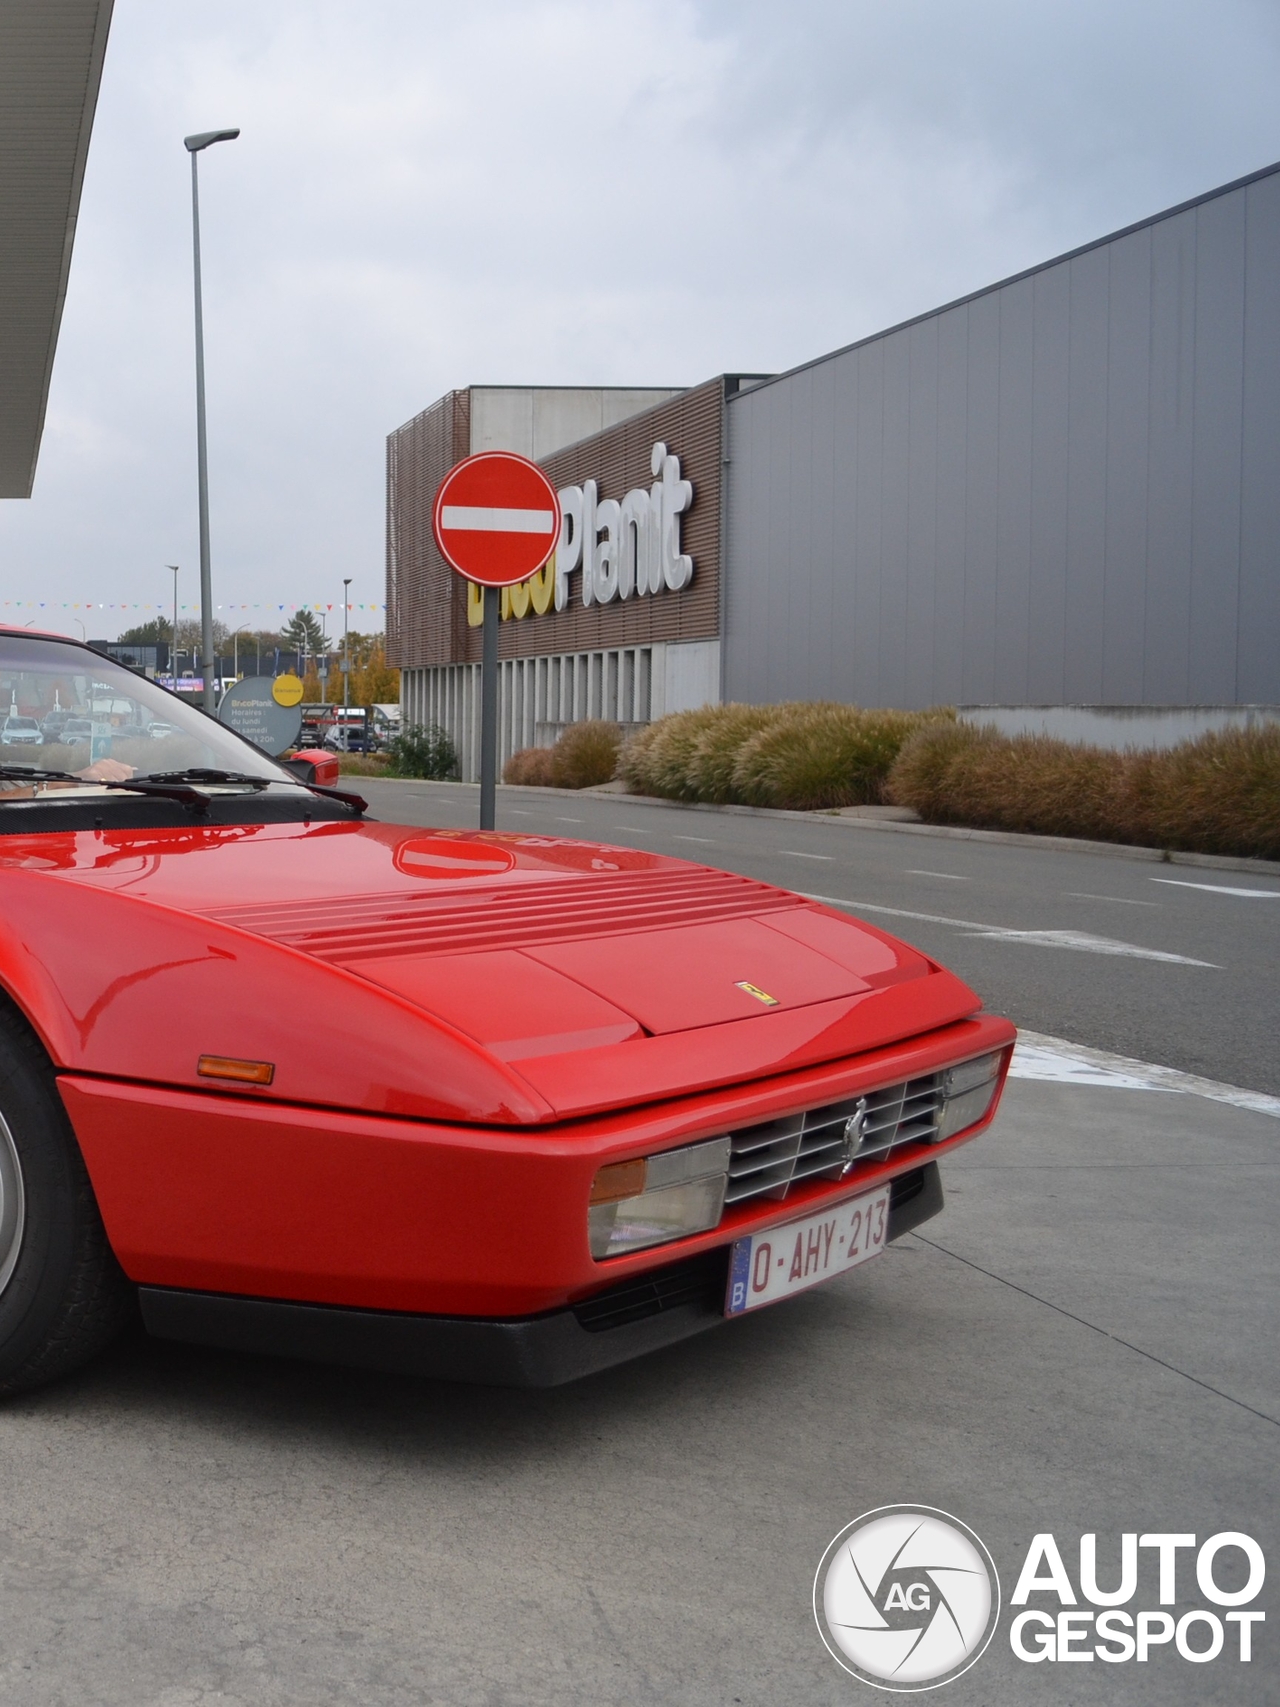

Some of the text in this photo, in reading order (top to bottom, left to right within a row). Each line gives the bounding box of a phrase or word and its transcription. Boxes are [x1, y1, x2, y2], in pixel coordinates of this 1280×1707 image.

[467, 442, 694, 626] Planit
[231, 700, 273, 708] BricoPlanit
[732, 1282, 745, 1306] B
